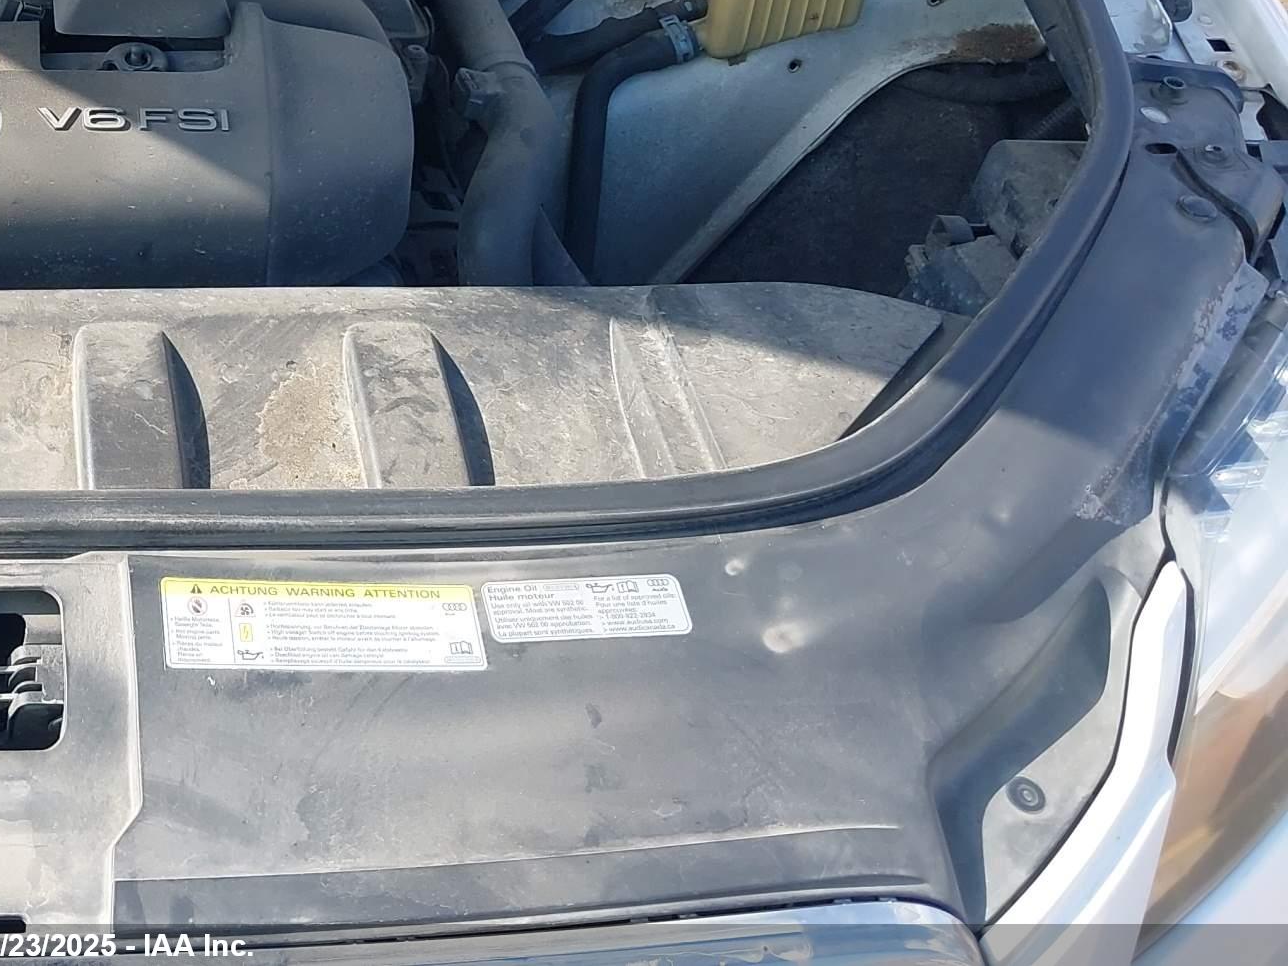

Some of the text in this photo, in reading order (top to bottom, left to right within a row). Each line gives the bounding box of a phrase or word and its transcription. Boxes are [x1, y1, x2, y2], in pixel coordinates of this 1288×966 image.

[36, 107, 230, 132] V6 FSI
[210, 585, 441, 599] ACHTUNG WARNING ATTENTION
[487, 586, 521, 594] Engine
